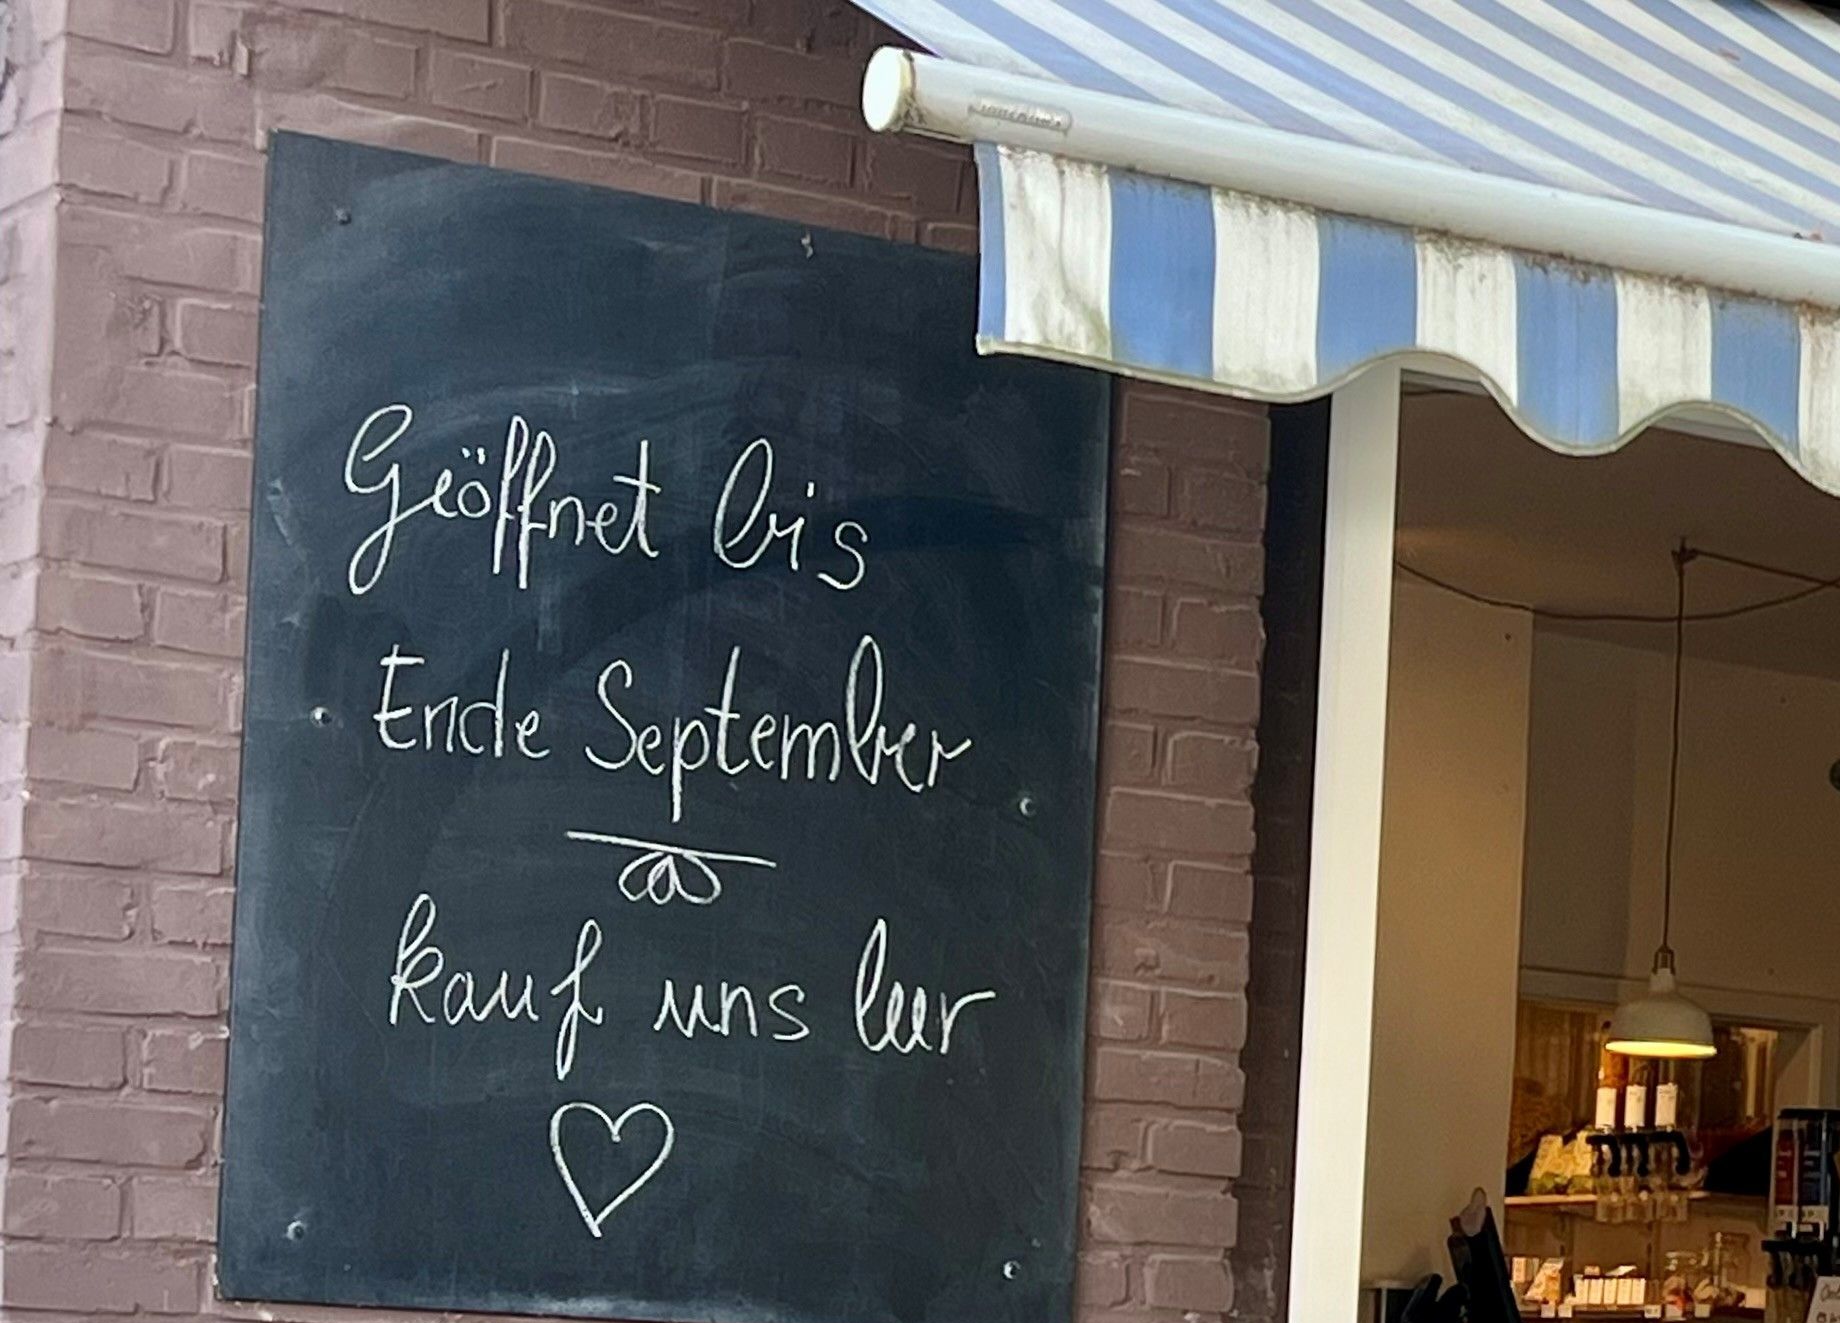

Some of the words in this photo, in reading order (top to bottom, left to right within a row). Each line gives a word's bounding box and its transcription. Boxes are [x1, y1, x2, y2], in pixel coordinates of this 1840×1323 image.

[345, 405, 661, 594] Geöffnet
[714, 438, 867, 589] bis
[373, 644, 549, 758] Ende
[585, 635, 971, 822] September
[390, 894, 603, 1080] kauf
[654, 980, 809, 1040] uns
[856, 919, 996, 1054] leer
